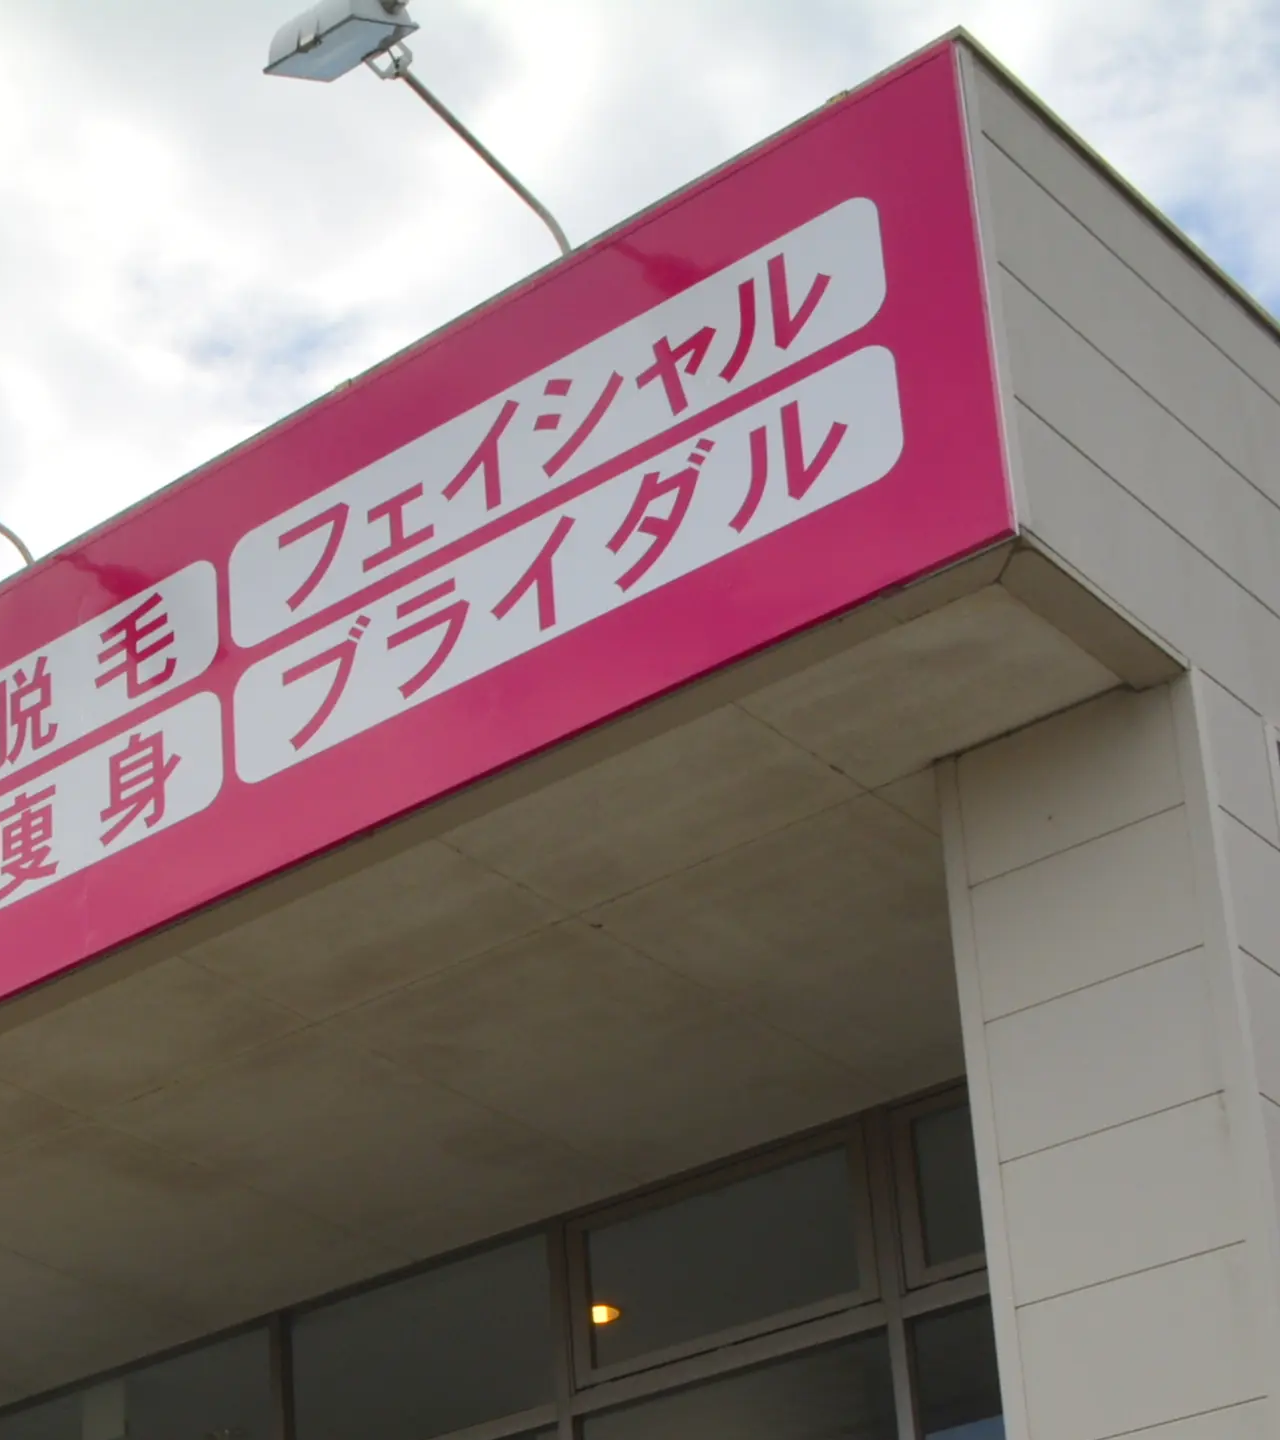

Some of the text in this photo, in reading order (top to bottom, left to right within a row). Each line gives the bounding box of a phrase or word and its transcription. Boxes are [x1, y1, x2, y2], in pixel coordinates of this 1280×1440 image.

[275, 250, 833, 613] フェイシャル
[279, 398, 850, 752] ブライダル
